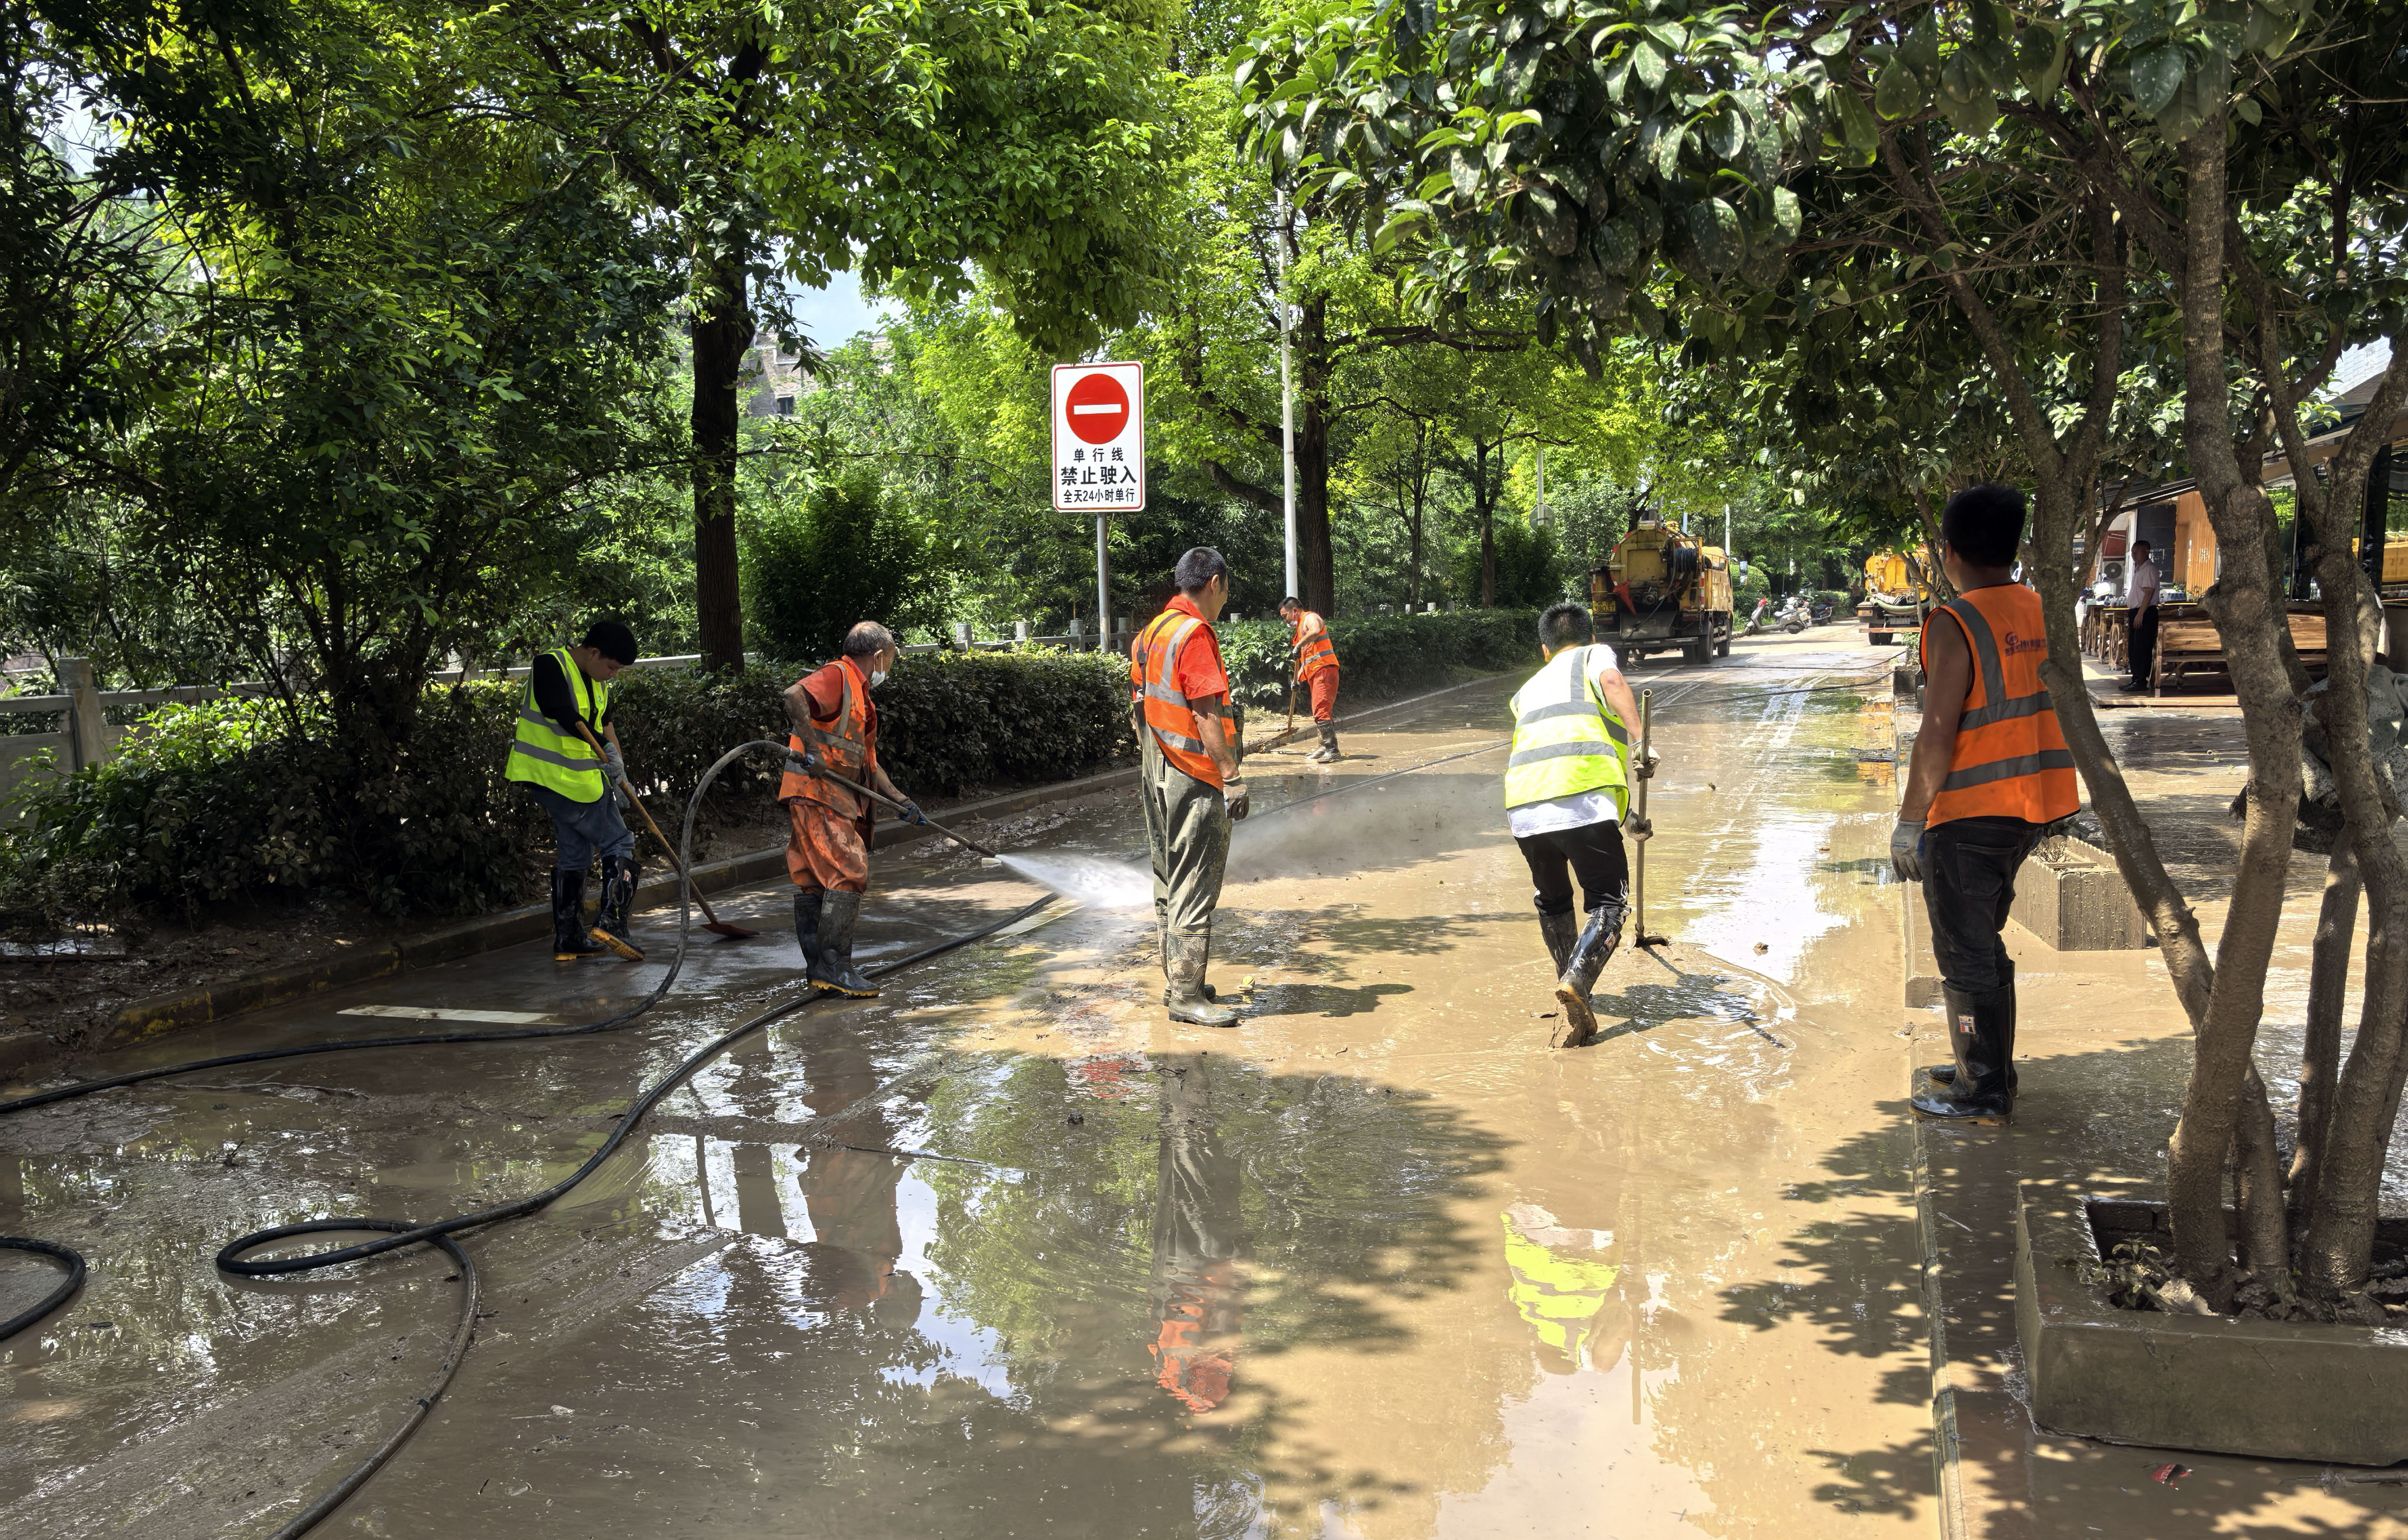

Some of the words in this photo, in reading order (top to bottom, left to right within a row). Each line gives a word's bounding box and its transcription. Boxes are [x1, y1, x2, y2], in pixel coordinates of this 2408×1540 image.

[1073, 447, 1123, 463] 单行线
[1061, 466, 1136, 486] 禁止驶入
[1063, 488, 1135, 503] 全天24小时单行
